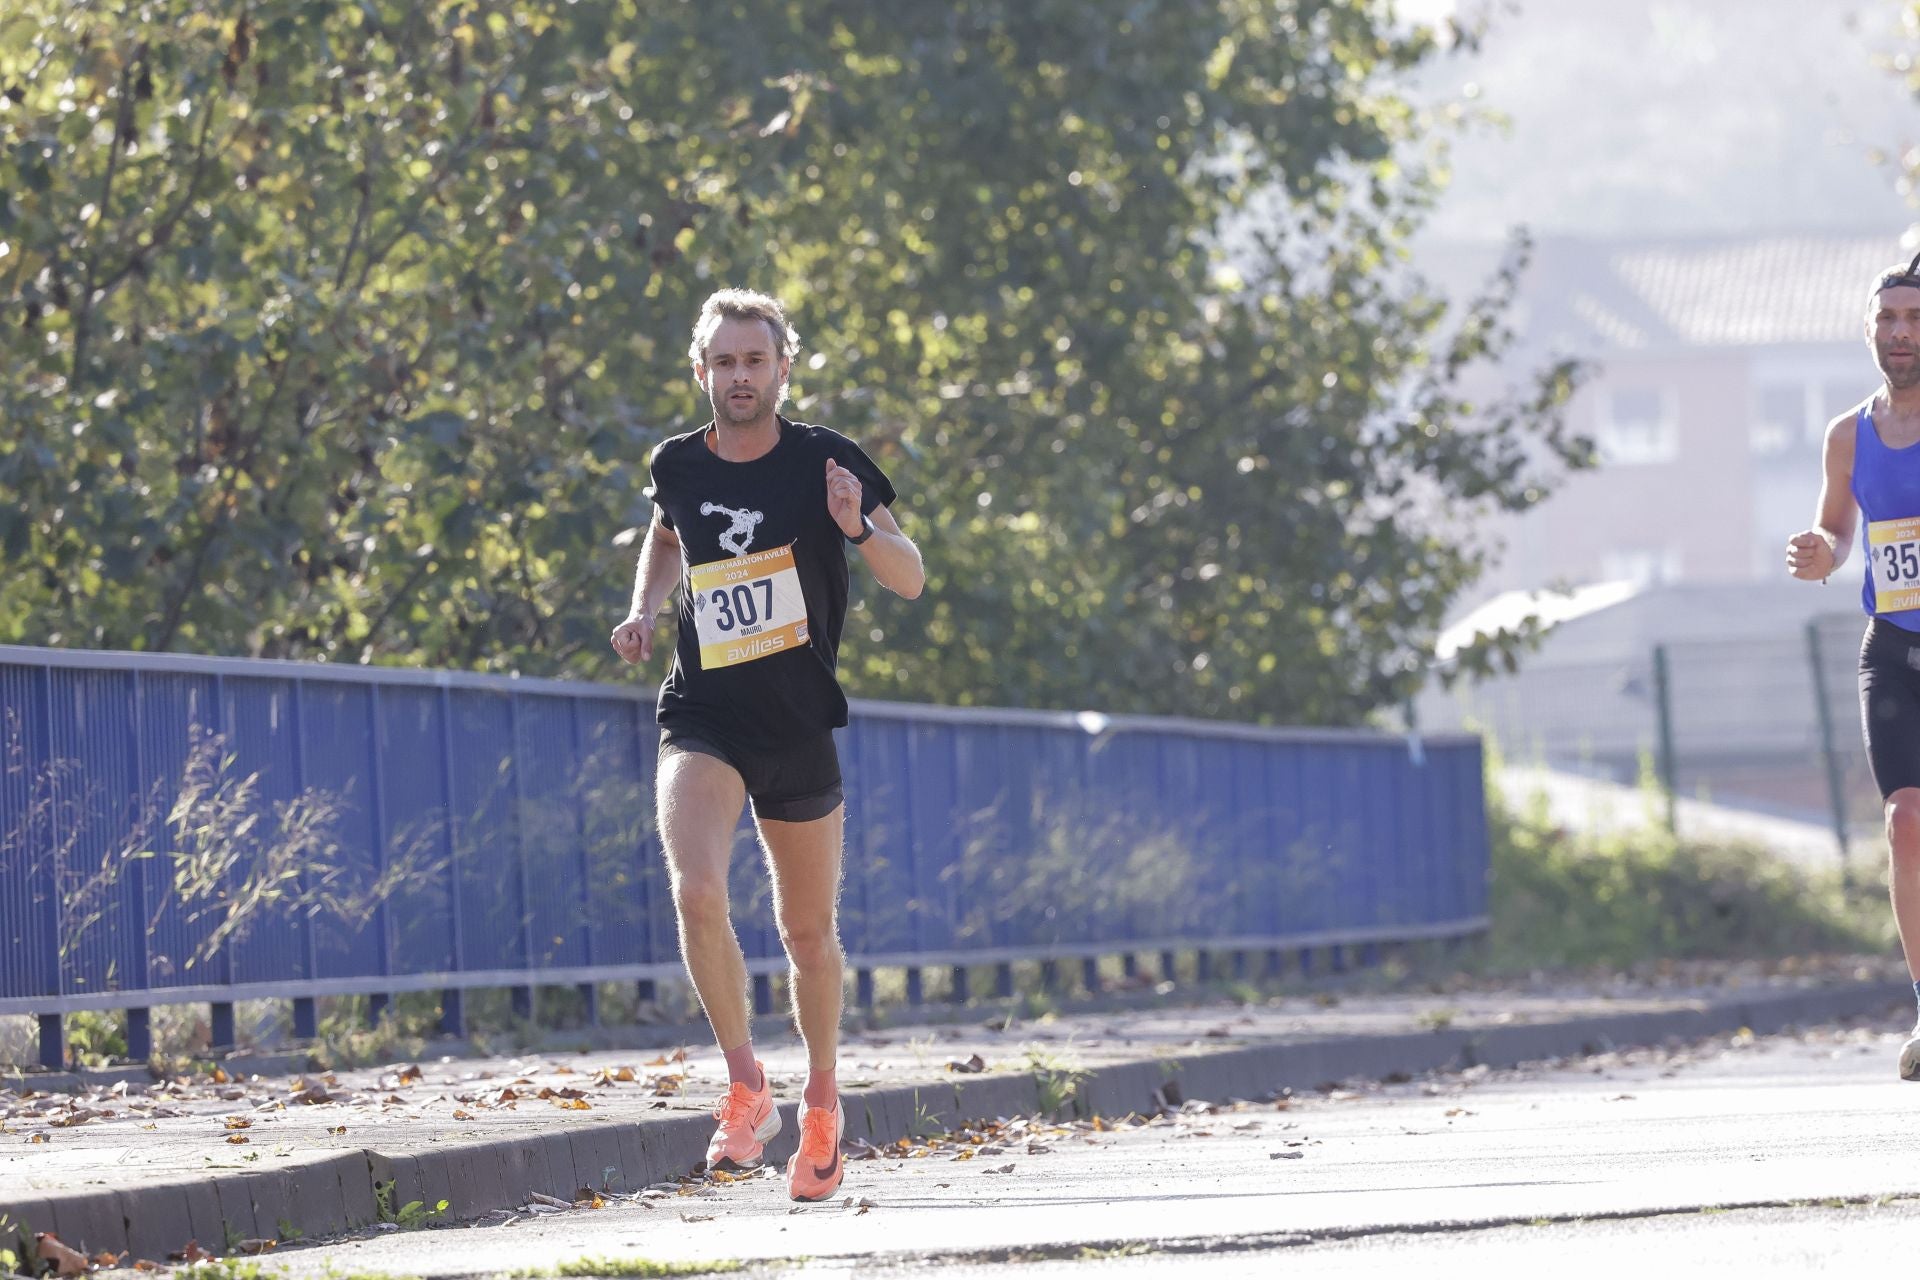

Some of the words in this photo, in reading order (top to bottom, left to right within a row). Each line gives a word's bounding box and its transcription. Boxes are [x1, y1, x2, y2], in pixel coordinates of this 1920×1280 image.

[726, 555, 763, 570] MARATÓN
[764, 547, 789, 561] AVILÉS
[1884, 542, 1920, 582] 35
[725, 569, 749, 581] 2024
[711, 578, 773, 631] 307
[740, 624, 763, 637] MAURO
[728, 635, 784, 661] avilés
